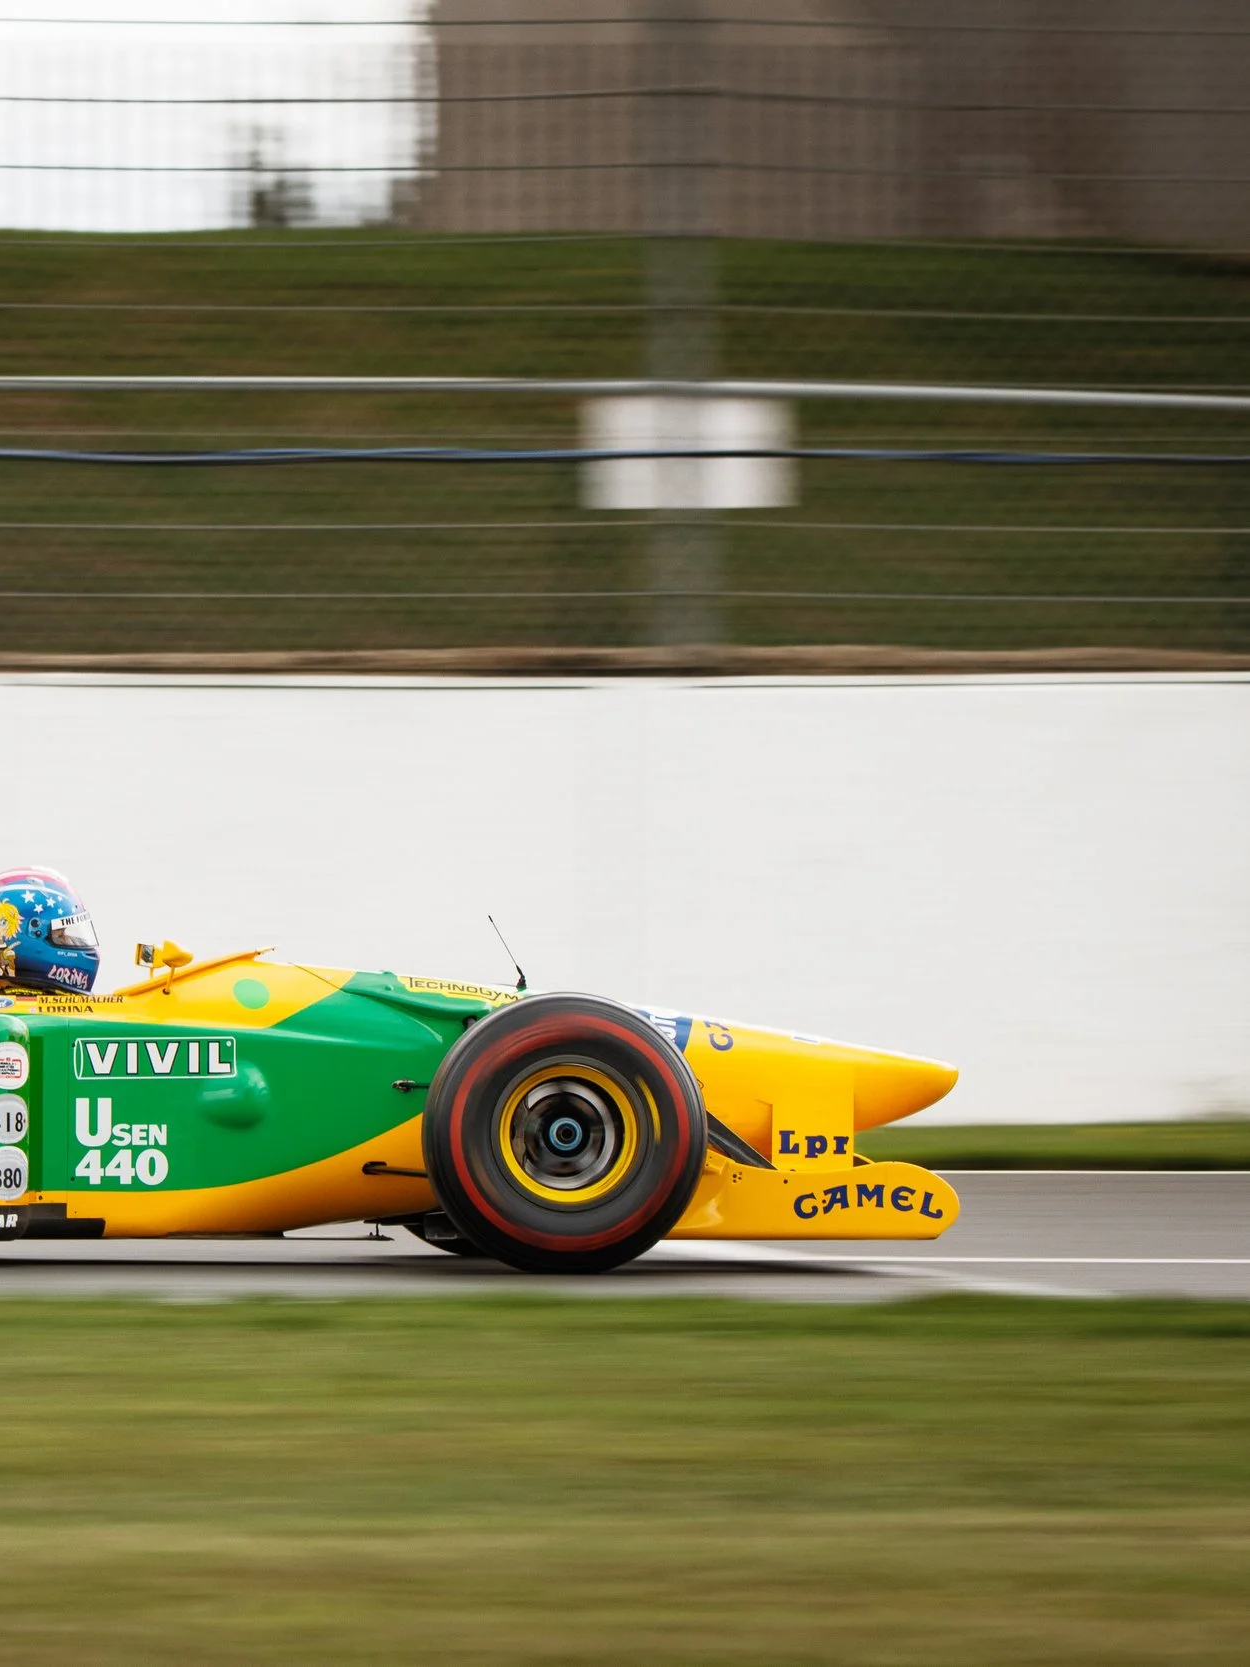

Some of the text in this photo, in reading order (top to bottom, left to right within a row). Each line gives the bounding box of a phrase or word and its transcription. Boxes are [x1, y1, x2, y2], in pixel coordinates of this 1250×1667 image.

[85, 1041, 231, 1074] VIVIL
[778, 1130, 849, 1158] Lpr
[75, 1148, 169, 1185] 440
[793, 1184, 943, 1219] CAMEL
